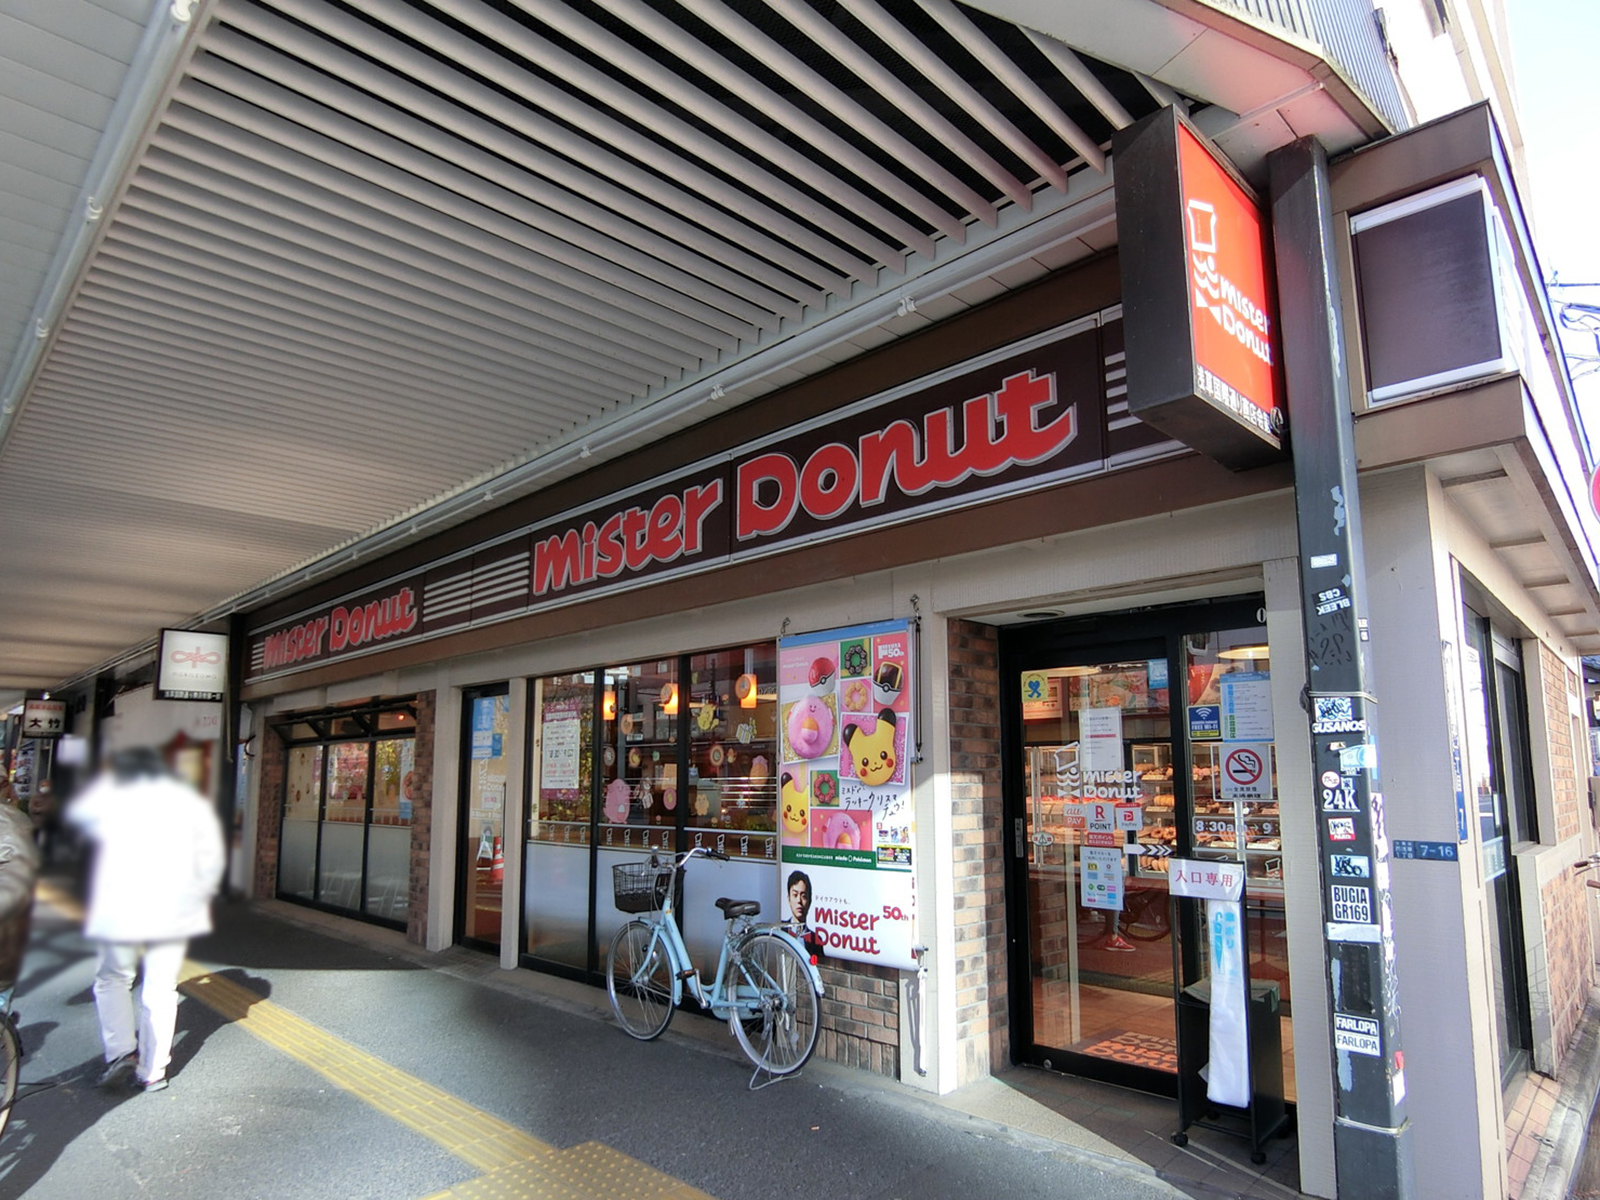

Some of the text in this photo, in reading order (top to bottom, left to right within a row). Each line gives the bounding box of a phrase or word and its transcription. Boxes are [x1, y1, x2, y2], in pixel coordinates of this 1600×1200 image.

[1222, 304, 1273, 366] Donut
[736, 367, 1078, 542] Donut
[1319, 588, 1341, 602] CBS
[1316, 598, 1351, 615] BLEEK
[330, 587, 417, 651] Donut
[1312, 720, 1366, 733] GUSANOS
[1083, 785, 1143, 799] Donut
[1323, 789, 1358, 810] 24K
[1095, 805, 1105, 819] R
[1067, 817, 1082, 825] PAY
[1089, 822, 1112, 831] POINT
[1420, 844, 1454, 857] 7-16
[1175, 869, 1233, 888] 入口専用
[1333, 886, 1368, 904] BUGIA
[883, 905, 909, 921] 50th
[1334, 903, 1369, 922] GR169
[815, 926, 881, 955] Donut
[1336, 1017, 1377, 1035] FARLOPA
[1337, 1034, 1378, 1051] FARLOPA
